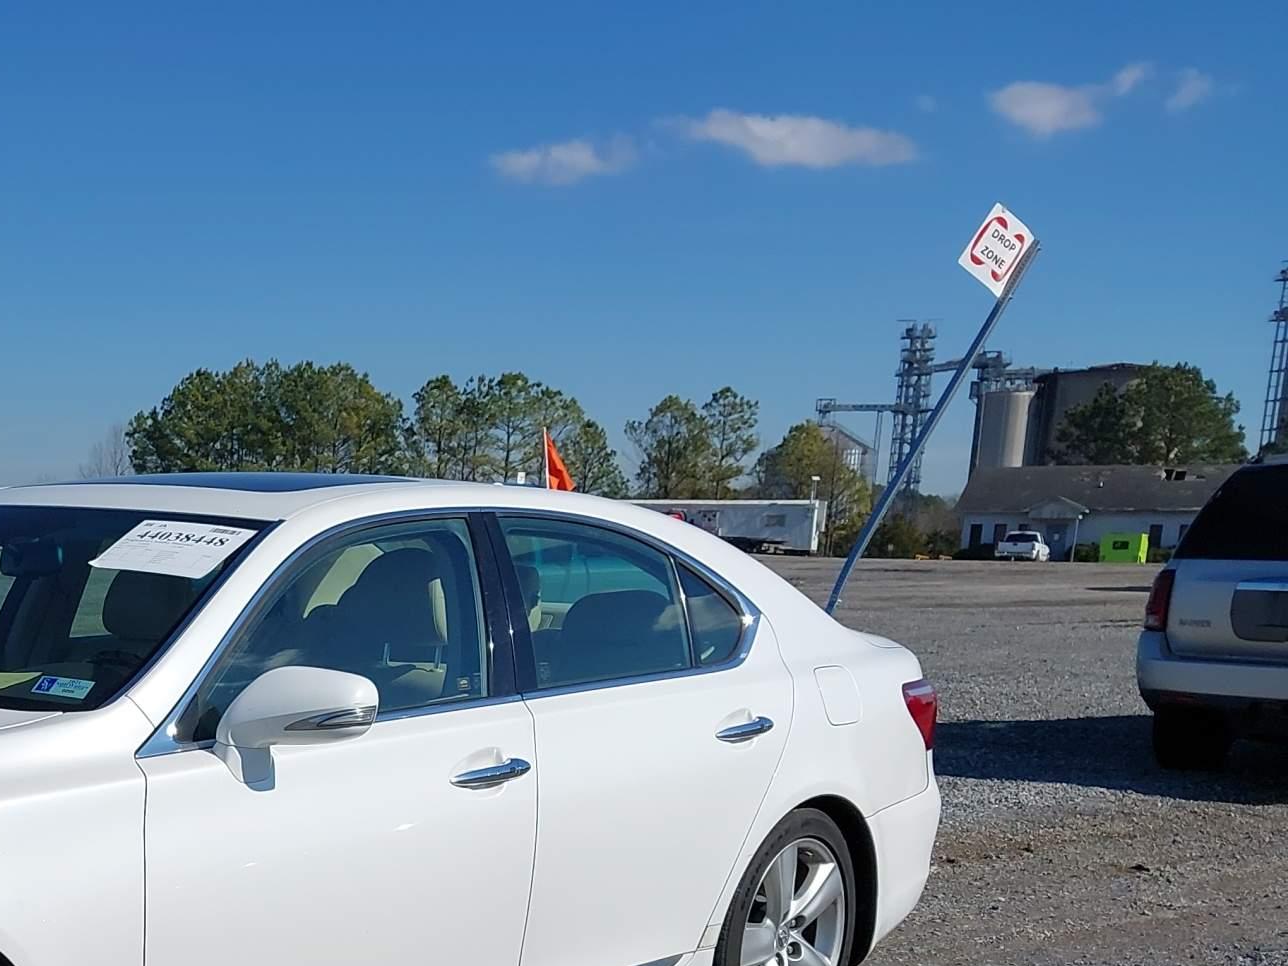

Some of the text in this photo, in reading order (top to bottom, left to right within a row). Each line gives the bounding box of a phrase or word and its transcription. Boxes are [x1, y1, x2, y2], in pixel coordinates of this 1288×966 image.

[991, 229, 1017, 251] DROP
[980, 246, 1006, 270] ZONE
[137, 530, 230, 548] 44038448
